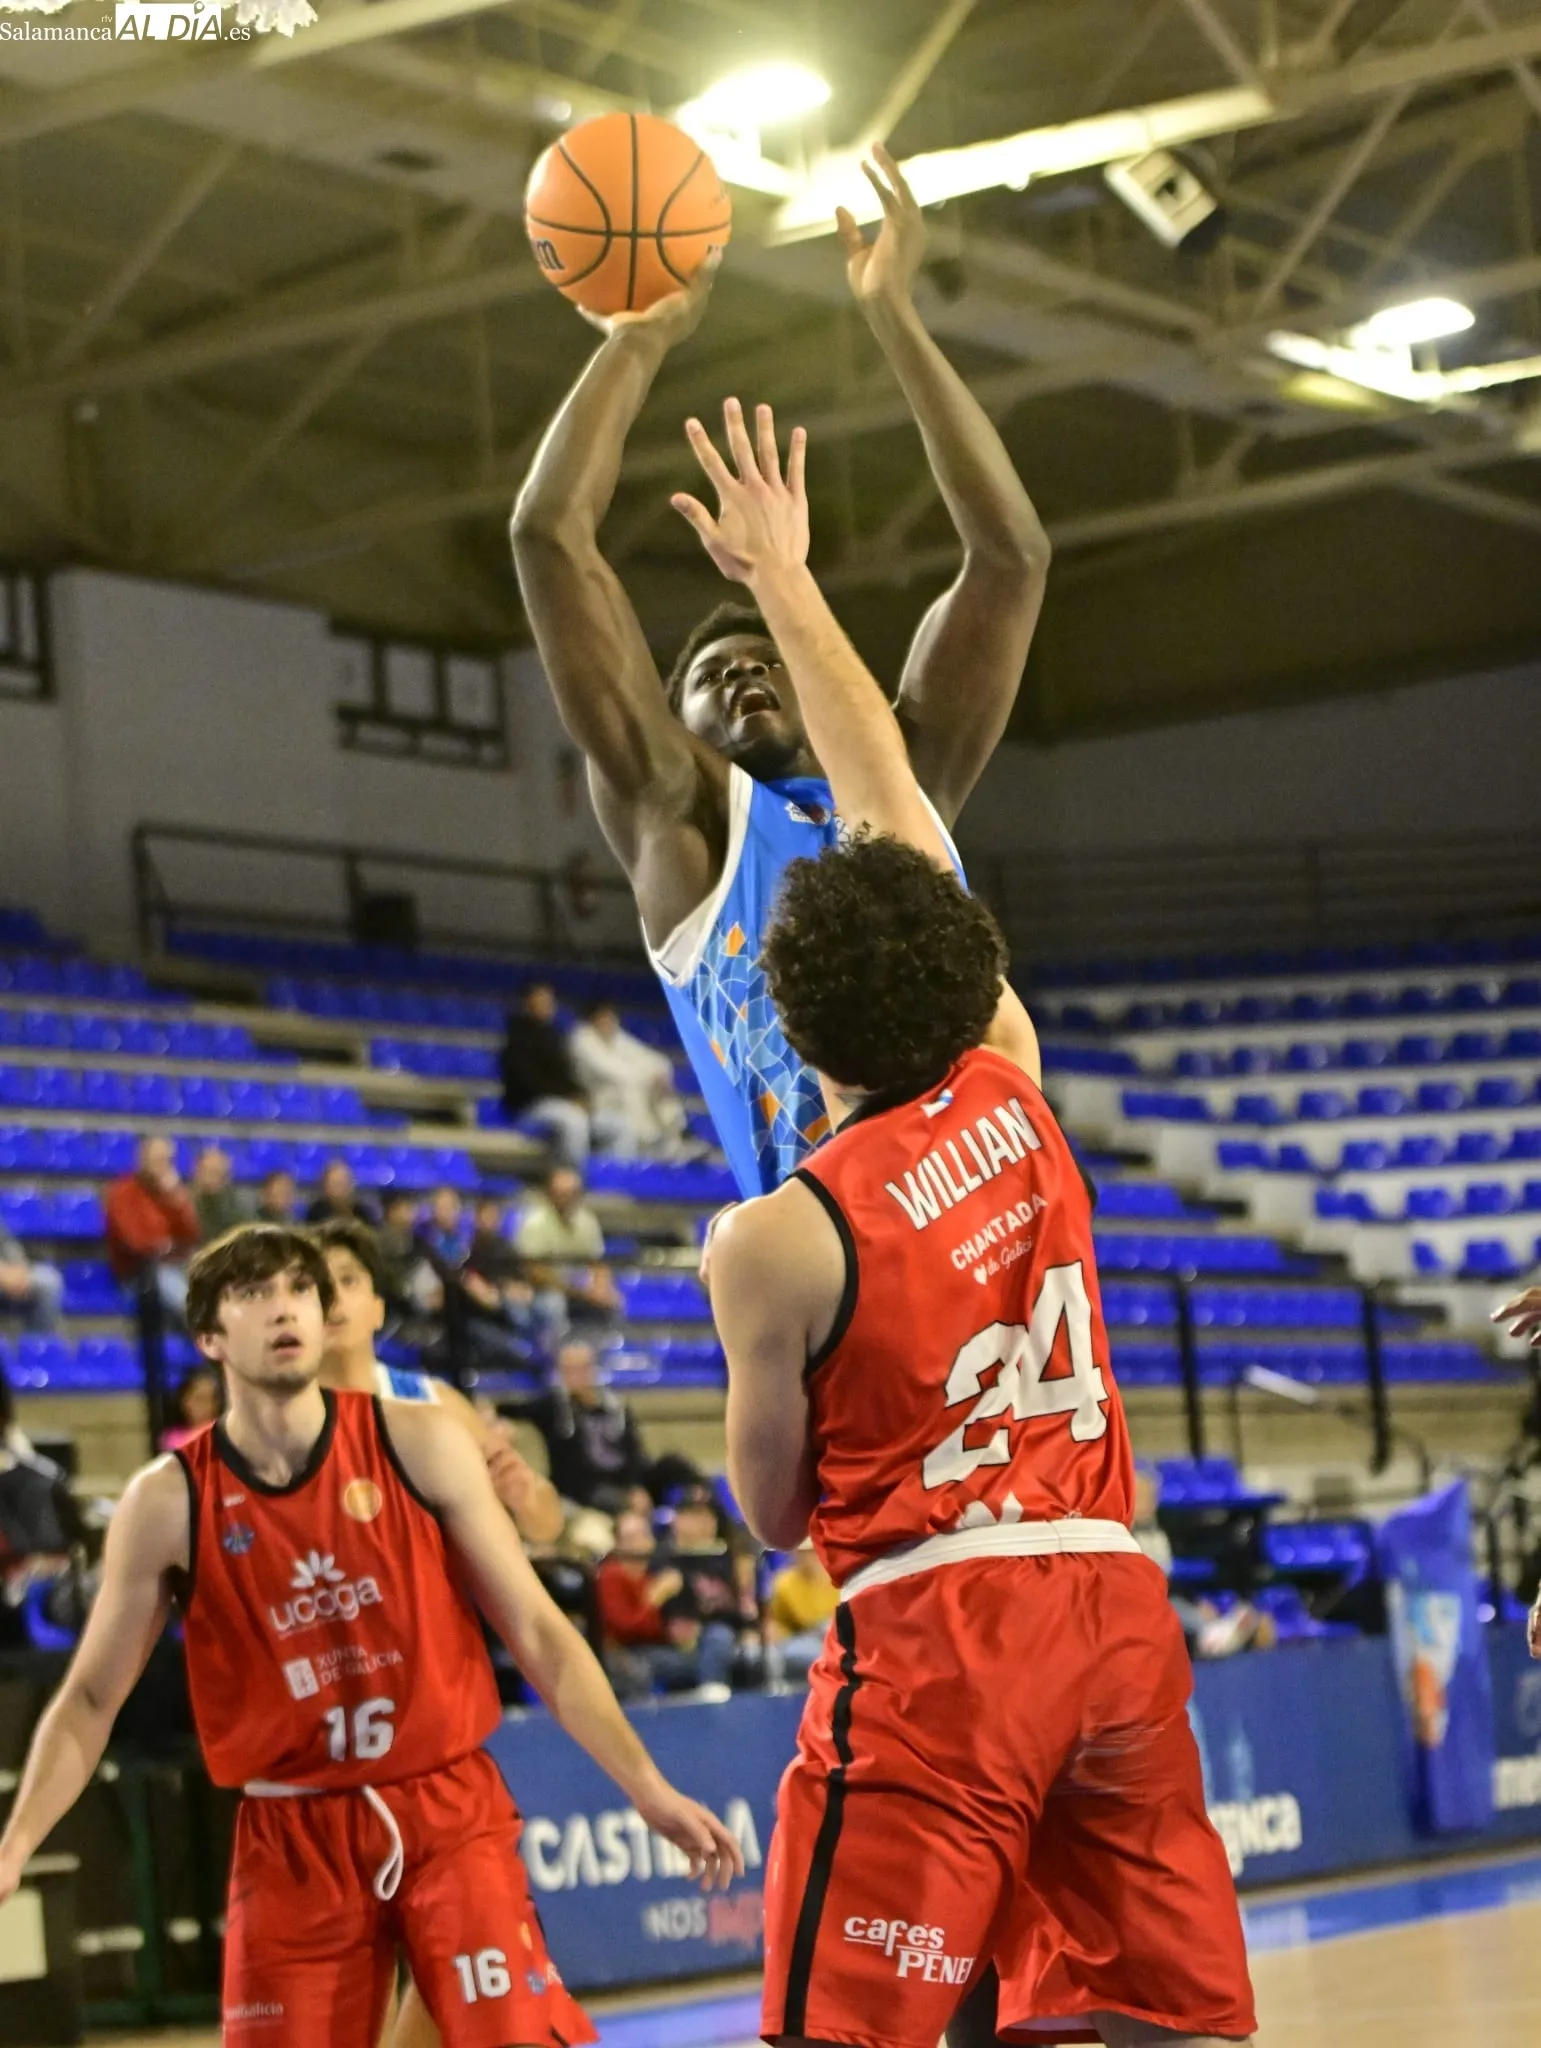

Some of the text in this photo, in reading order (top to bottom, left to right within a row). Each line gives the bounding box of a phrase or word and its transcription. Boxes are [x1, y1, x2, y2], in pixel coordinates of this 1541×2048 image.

[884, 1096, 1042, 1231] WILLIAN
[951, 1193, 1048, 1270] CHANTADA
[1001, 1236, 1032, 1270] Galici
[922, 1258, 1109, 1491] 24
[269, 1575, 384, 1632] ucoga
[317, 1645, 368, 1671] XUNTA
[320, 1667, 341, 1685] DE
[324, 1696, 396, 1762] 16
[454, 1947, 512, 2004] 16
